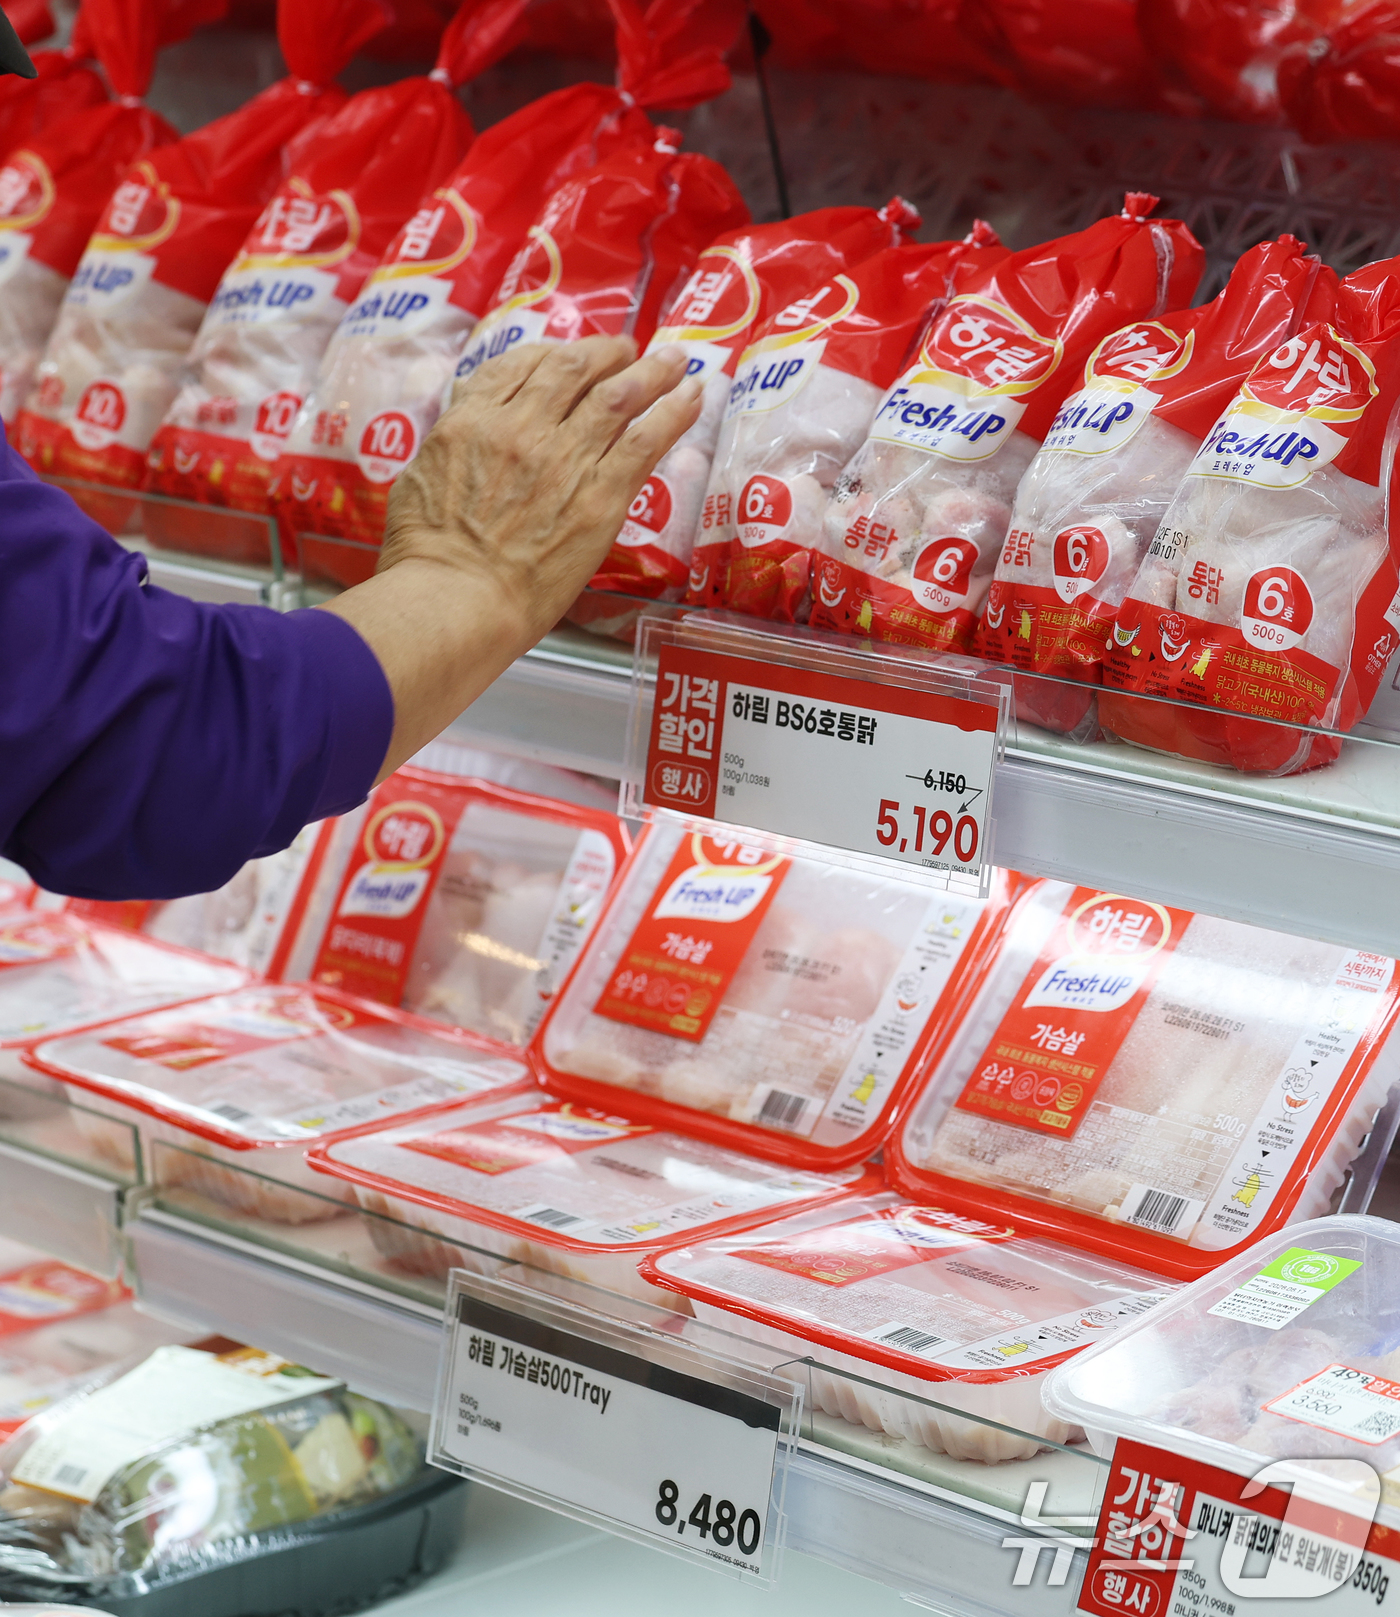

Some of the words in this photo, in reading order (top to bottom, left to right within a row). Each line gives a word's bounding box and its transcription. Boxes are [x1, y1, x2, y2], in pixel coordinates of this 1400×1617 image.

[382, 291, 429, 320] UP
[685, 358, 705, 375] P
[950, 314, 1048, 385] 하림
[760, 359, 804, 390] UP
[1269, 338, 1351, 404] 하림
[876, 388, 957, 433] Fresh
[950, 411, 1006, 442] UP
[1197, 421, 1270, 458] Fresh
[1262, 432, 1319, 466] UP
[1212, 460, 1256, 476] 프레쉬업
[746, 482, 774, 519] 6호
[844, 515, 898, 560] 통닭
[1003, 529, 1035, 567] 통닭
[923, 586, 950, 606] 500g
[1187, 561, 1225, 605] 통닭
[1258, 576, 1294, 622] 6호
[1251, 624, 1285, 645] 500g
[1223, 651, 1235, 665] 국내
[1237, 654, 1250, 669] 최초
[1250, 659, 1280, 679] 동물복지
[1281, 667, 1314, 693] 생산시스템
[1367, 653, 1382, 668] OTHER
[661, 672, 719, 719] 가격
[1181, 678, 1206, 692] Freshness
[732, 691, 770, 724] 하림
[775, 700, 878, 746] BS6호통닭
[658, 712, 715, 760] 할인
[724, 753, 744, 768] 500g
[661, 766, 703, 800] 행사
[924, 769, 966, 795] 6,150
[876, 798, 979, 863] 5,190
[672, 881, 722, 904] Fresh
[724, 886, 755, 906] UP
[1090, 906, 1153, 952] 하림
[660, 931, 713, 965] 가슴살
[1043, 970, 1098, 993] Fresh
[1099, 975, 1134, 996] UP
[1344, 961, 1387, 981] 식탁까지
[1030, 1023, 1086, 1056] 가슴살
[1318, 1032, 1342, 1044] Healthy
[1213, 1113, 1247, 1138] 500g
[1267, 1122, 1276, 1130] No
[1276, 1124, 1294, 1135] Stress
[1221, 1204, 1250, 1218] Freshness
[996, 1309, 1031, 1325] 500g
[468, 1334, 496, 1368] 하림
[499, 1345, 612, 1415] 가슴살500Tray
[1330, 1368, 1371, 1384] 49%
[1292, 1395, 1342, 1416] 3,560
[1112, 1466, 1185, 1528] 가격
[655, 1479, 761, 1556] 8,480
[1197, 1502, 1235, 1542] 마니커
[1233, 1515, 1295, 1564] 닭터의자연
[1105, 1510, 1177, 1574] 할인
[1103, 1571, 1152, 1614] 행사
[1181, 1569, 1207, 1590] 350g
